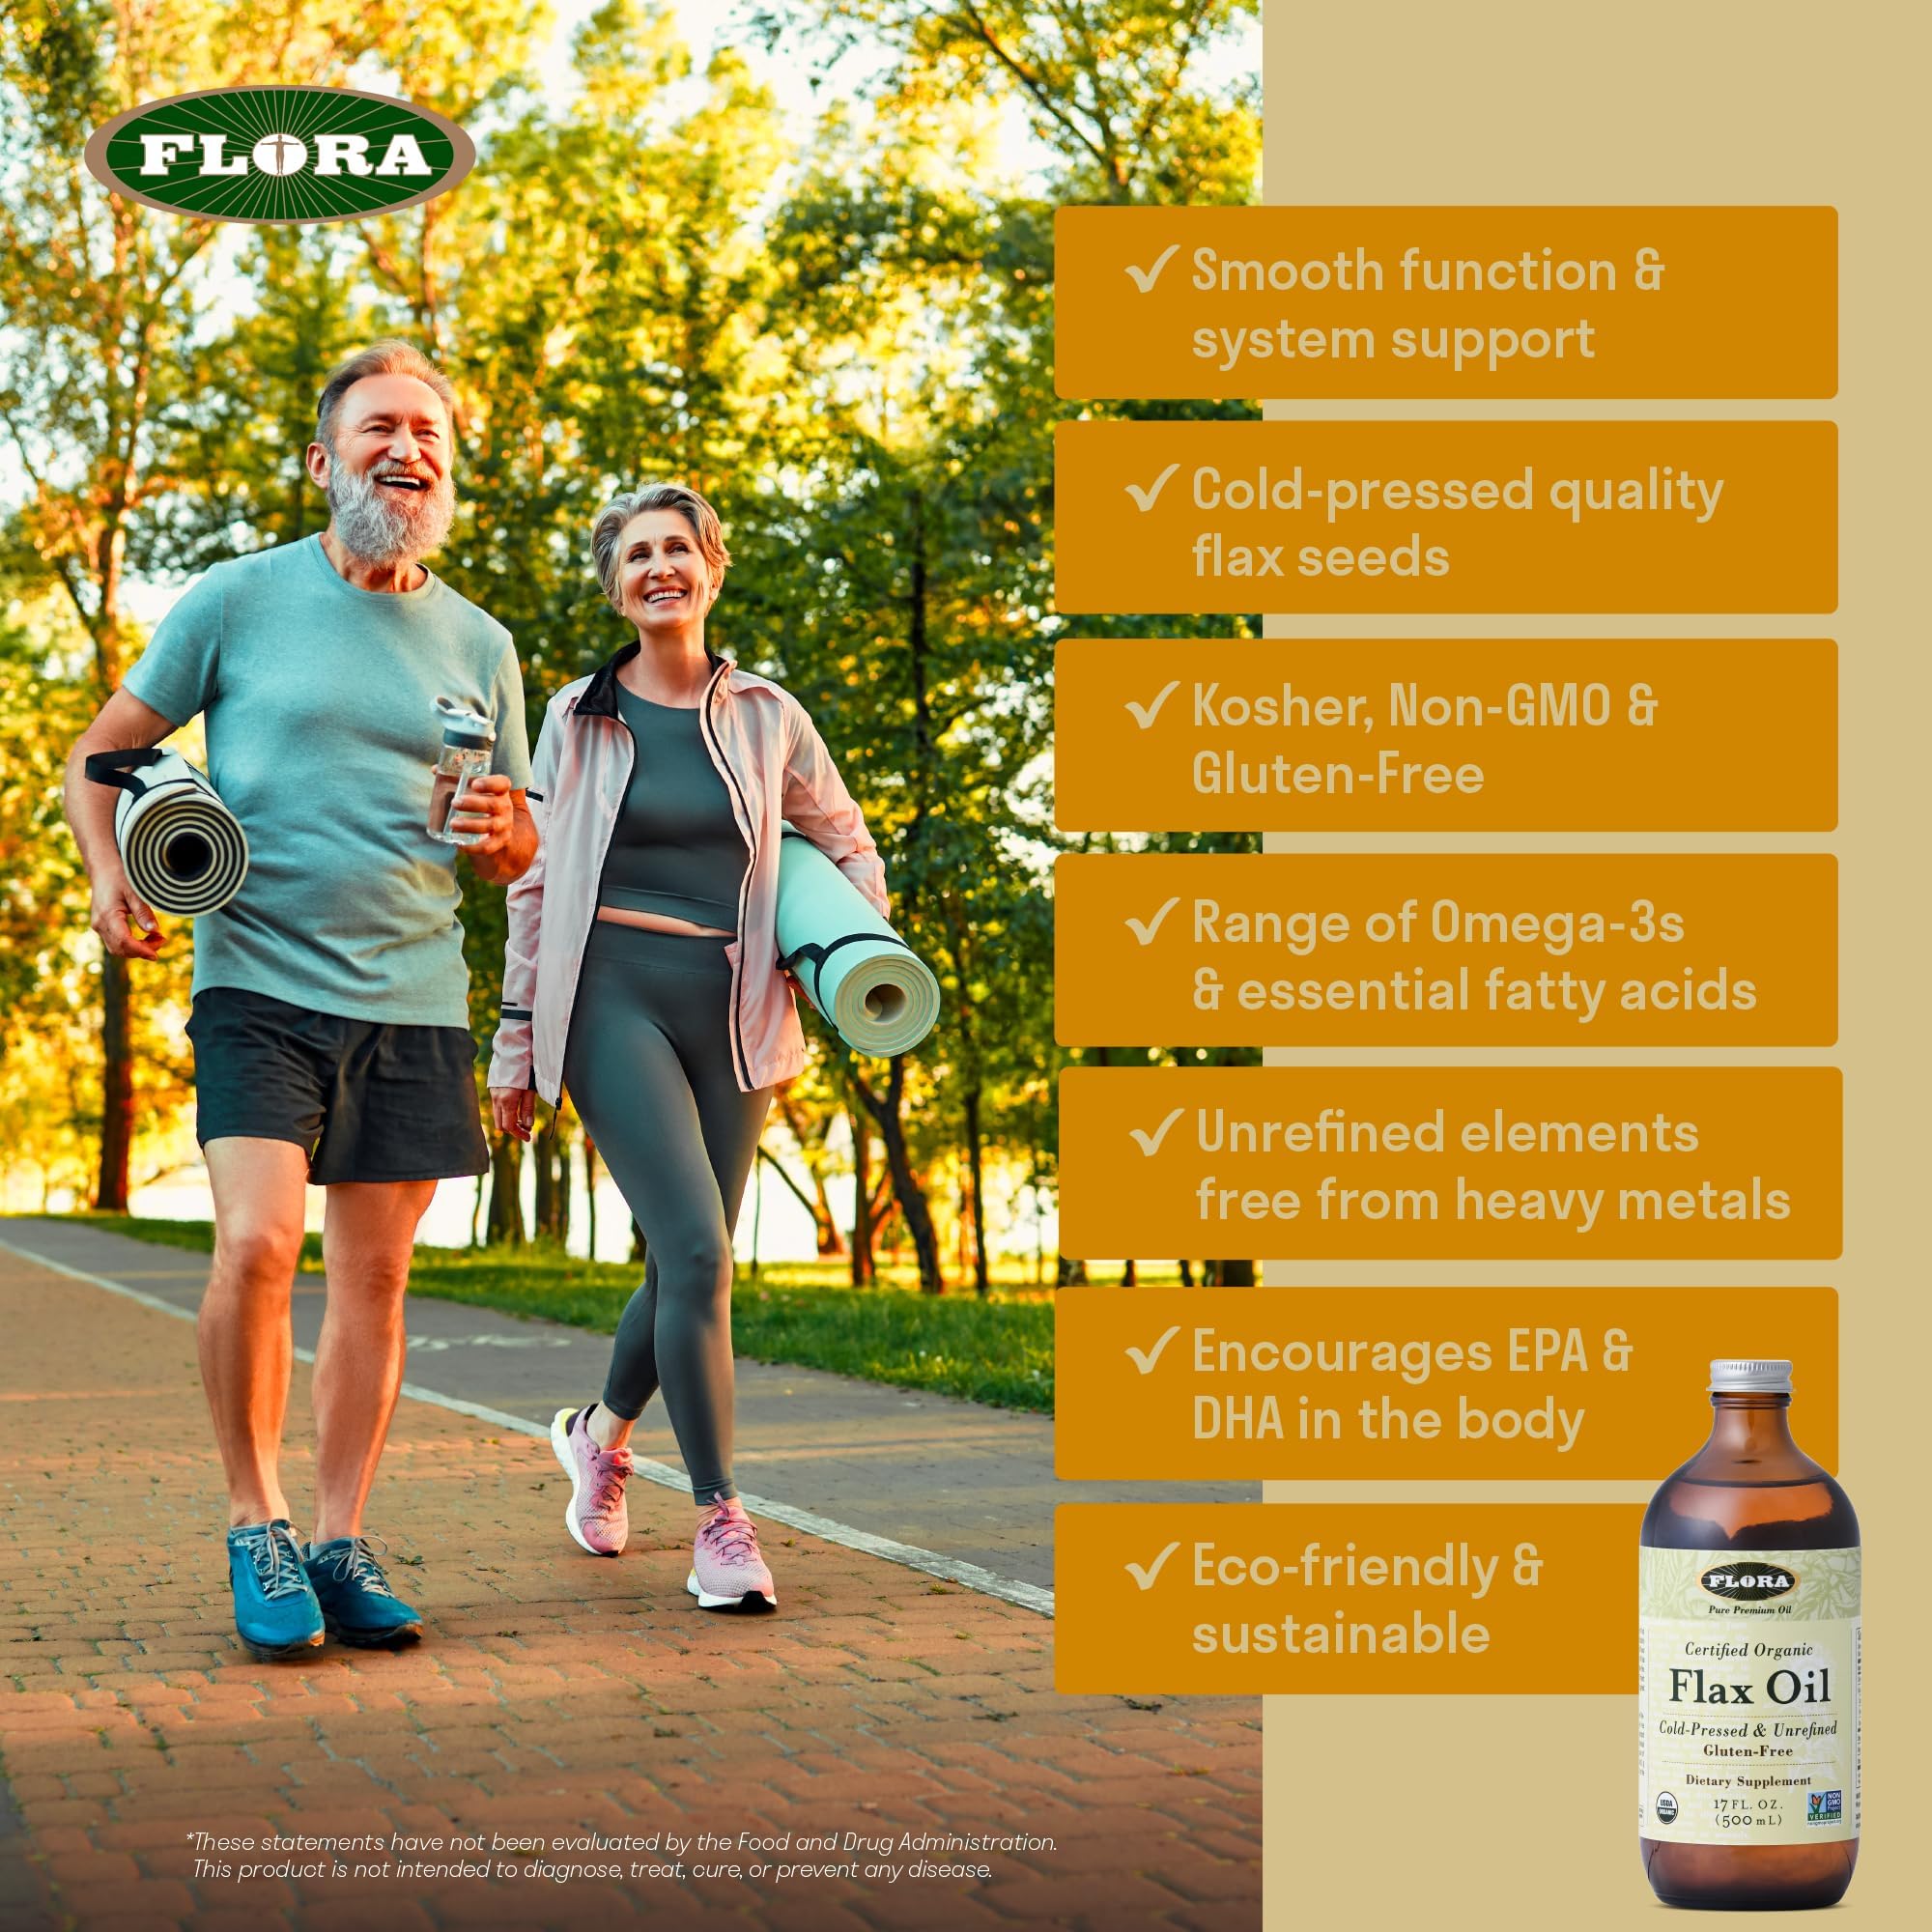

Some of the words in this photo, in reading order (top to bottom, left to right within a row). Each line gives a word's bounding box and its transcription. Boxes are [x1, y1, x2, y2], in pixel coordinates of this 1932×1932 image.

[1709, 1575, 1790, 1588] FLORA
[1709, 1605, 1730, 1614] Pure
[1733, 1605, 1775, 1614] Premium
[1777, 1605, 1792, 1614] Oil
[1685, 1642, 1748, 1661] Certified
[1753, 1642, 1813, 1661] Organic
[1669, 1668, 1754, 1704] Flax
[1766, 1668, 1832, 1705] Oil
[1660, 1720, 1748, 1738] Cold-Pressed
[1752, 1722, 1767, 1738] &
[1774, 1720, 1837, 1740] Unrefined
[1703, 1744, 1794, 1757] Gluten-Free
[1686, 1774, 1731, 1789] Dietary
[1737, 1776, 1811, 1790] Supplement
[1714, 1799, 1728, 1812] 17
[1758, 1799, 1783, 1809] OZ.
[1716, 1813, 1752, 1829] (500
[1756, 1813, 1782, 1826] mL)
